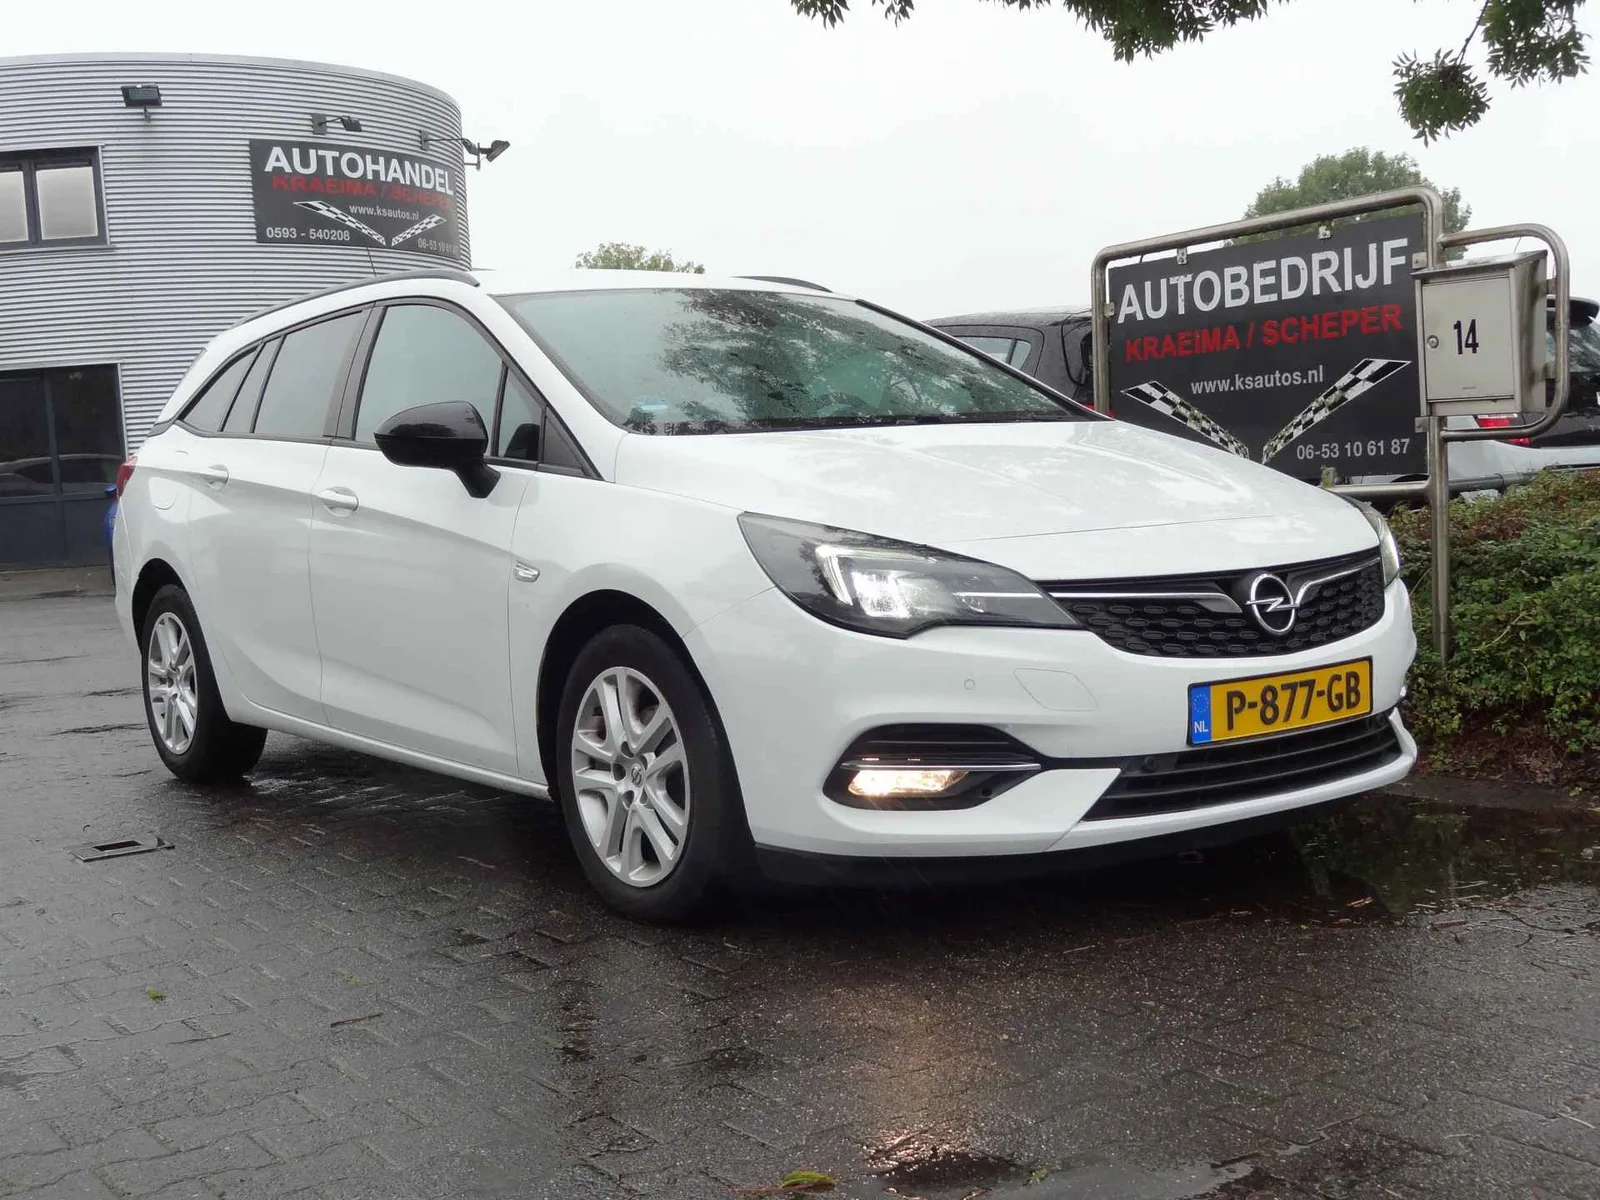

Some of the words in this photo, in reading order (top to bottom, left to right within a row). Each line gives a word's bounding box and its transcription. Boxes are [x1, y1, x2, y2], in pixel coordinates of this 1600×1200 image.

[264, 146, 454, 196] AUTOHANDEL
[272, 175, 375, 198] KRAEIMA
[349, 204, 420, 221] www.ksautos.nl
[266, 227, 297, 239] 0593
[309, 229, 350, 241] 540208
[1117, 238, 1408, 324] AUTOBEDRIJF
[1125, 325, 1241, 362] KRAEIMA
[1262, 304, 1404, 346] SCHEPER
[1453, 319, 1479, 355] 14
[1191, 365, 1324, 395] www.ksautos.nl
[1297, 443, 1339, 459] 06-53
[1345, 441, 1362, 457] 10
[1367, 440, 1384, 456] 61
[1391, 438, 1410, 454] 87
[1226, 671, 1361, 731] P-877-GB
[1194, 720, 1209, 733] NL
